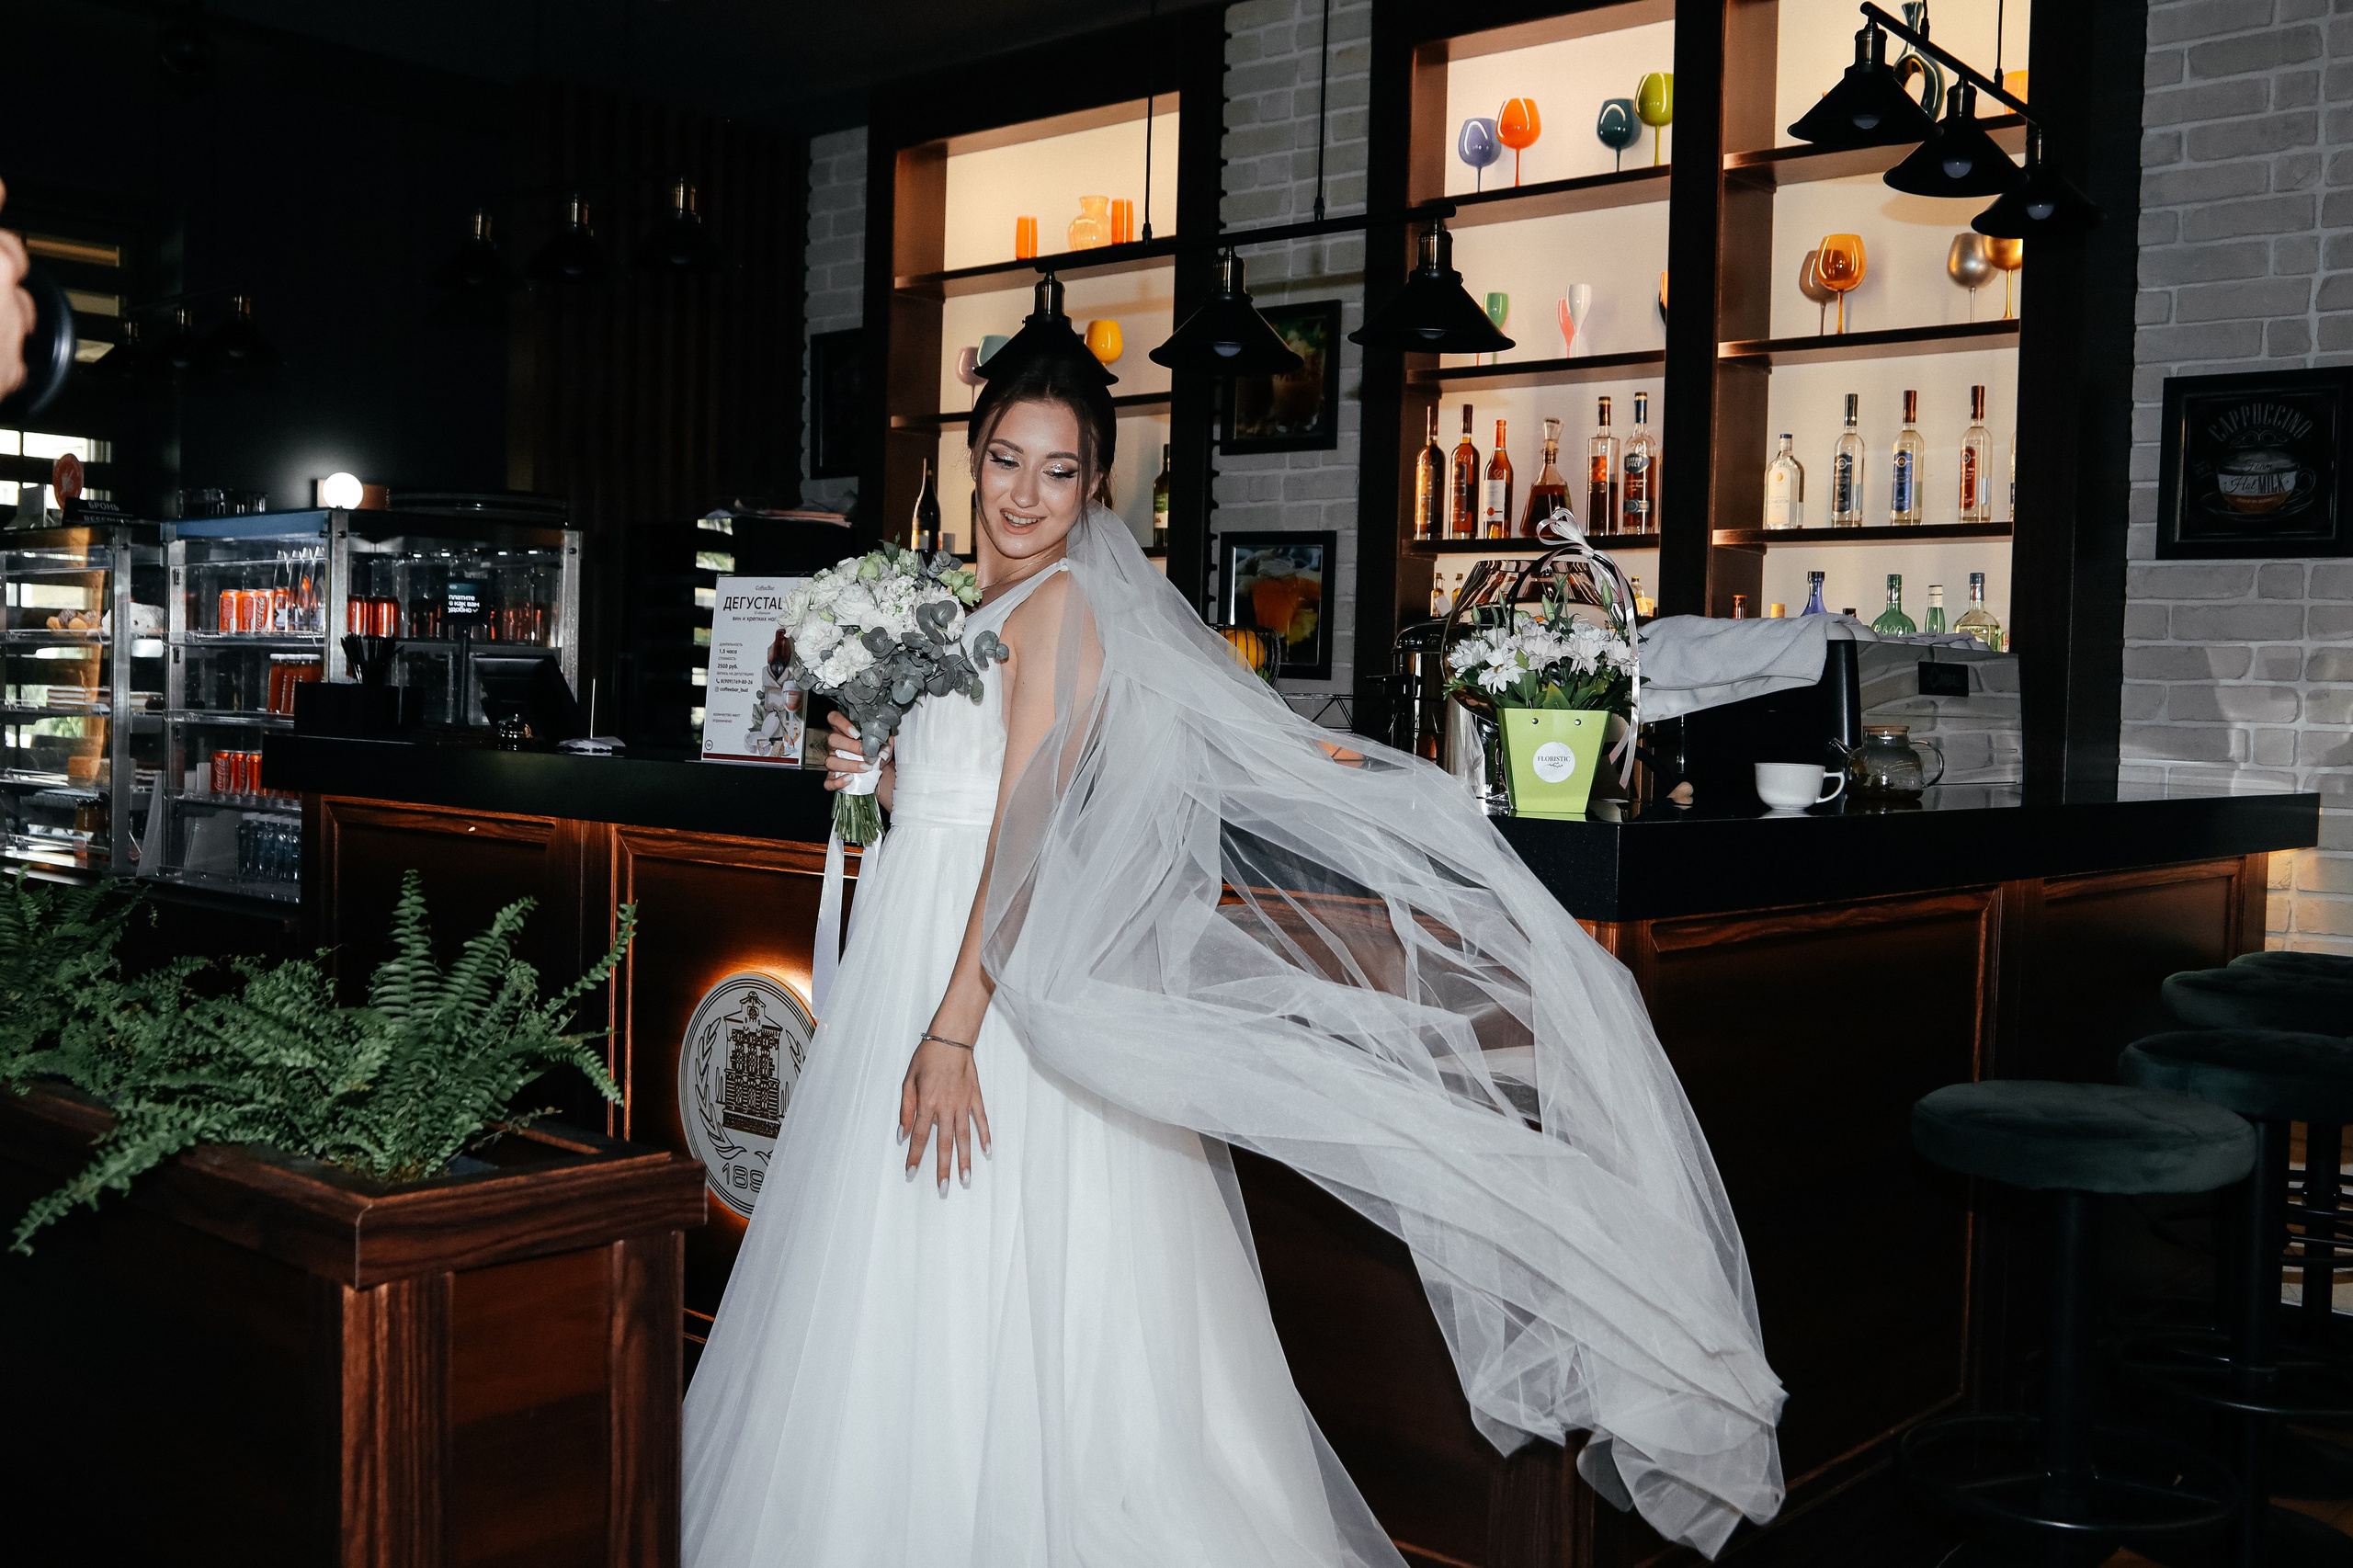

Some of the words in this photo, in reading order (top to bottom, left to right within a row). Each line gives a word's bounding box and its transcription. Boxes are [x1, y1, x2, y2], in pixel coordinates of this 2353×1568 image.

[2208, 403, 2313, 442] CAPPUCCINO
[2245, 459, 2273, 472] Foam
[2223, 476, 2256, 493] Hot
[2258, 473, 2286, 494] MILK
[88, 501, 119, 512] БРОНЬ
[448, 605, 472, 613] удобно
